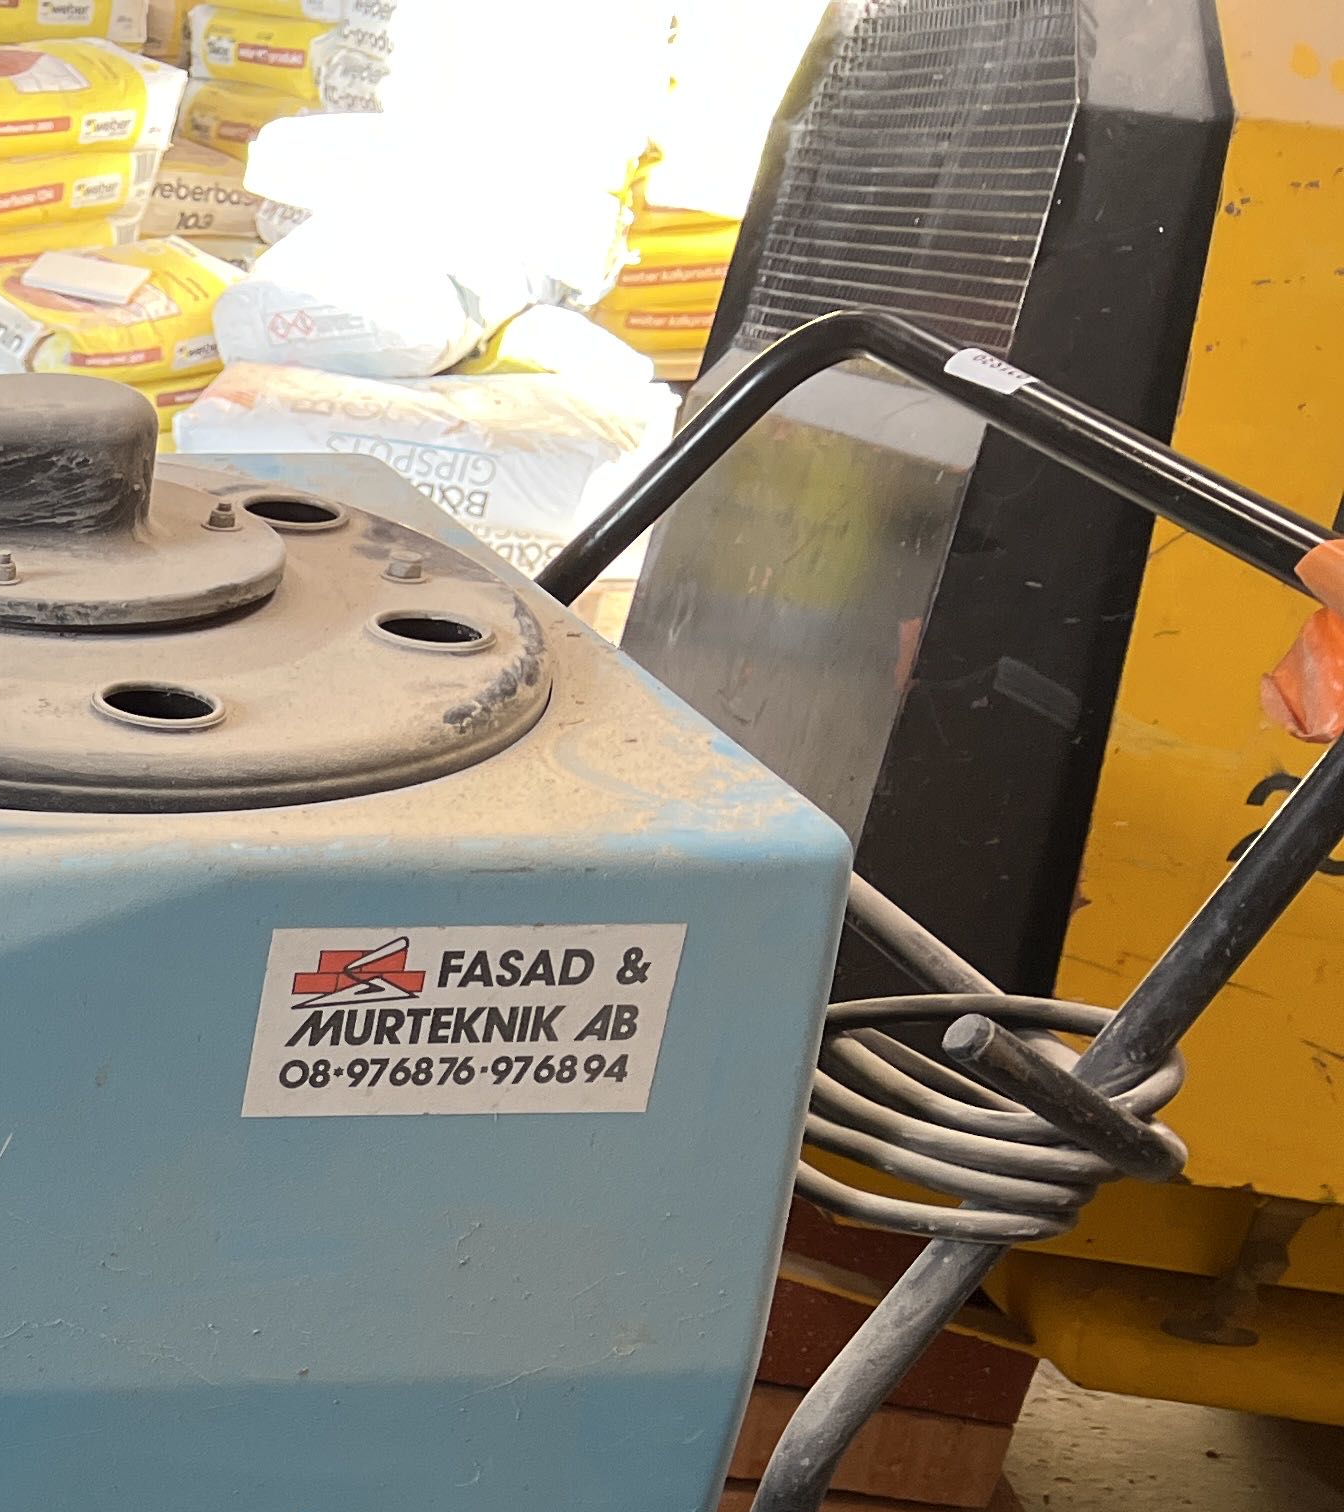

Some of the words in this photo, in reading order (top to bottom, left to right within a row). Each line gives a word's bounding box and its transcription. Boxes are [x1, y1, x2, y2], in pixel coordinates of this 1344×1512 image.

[437, 949, 595, 988] FASAD
[616, 946, 652, 985] &
[285, 1004, 566, 1048] MURTEKNIK
[574, 1004, 639, 1042] AB
